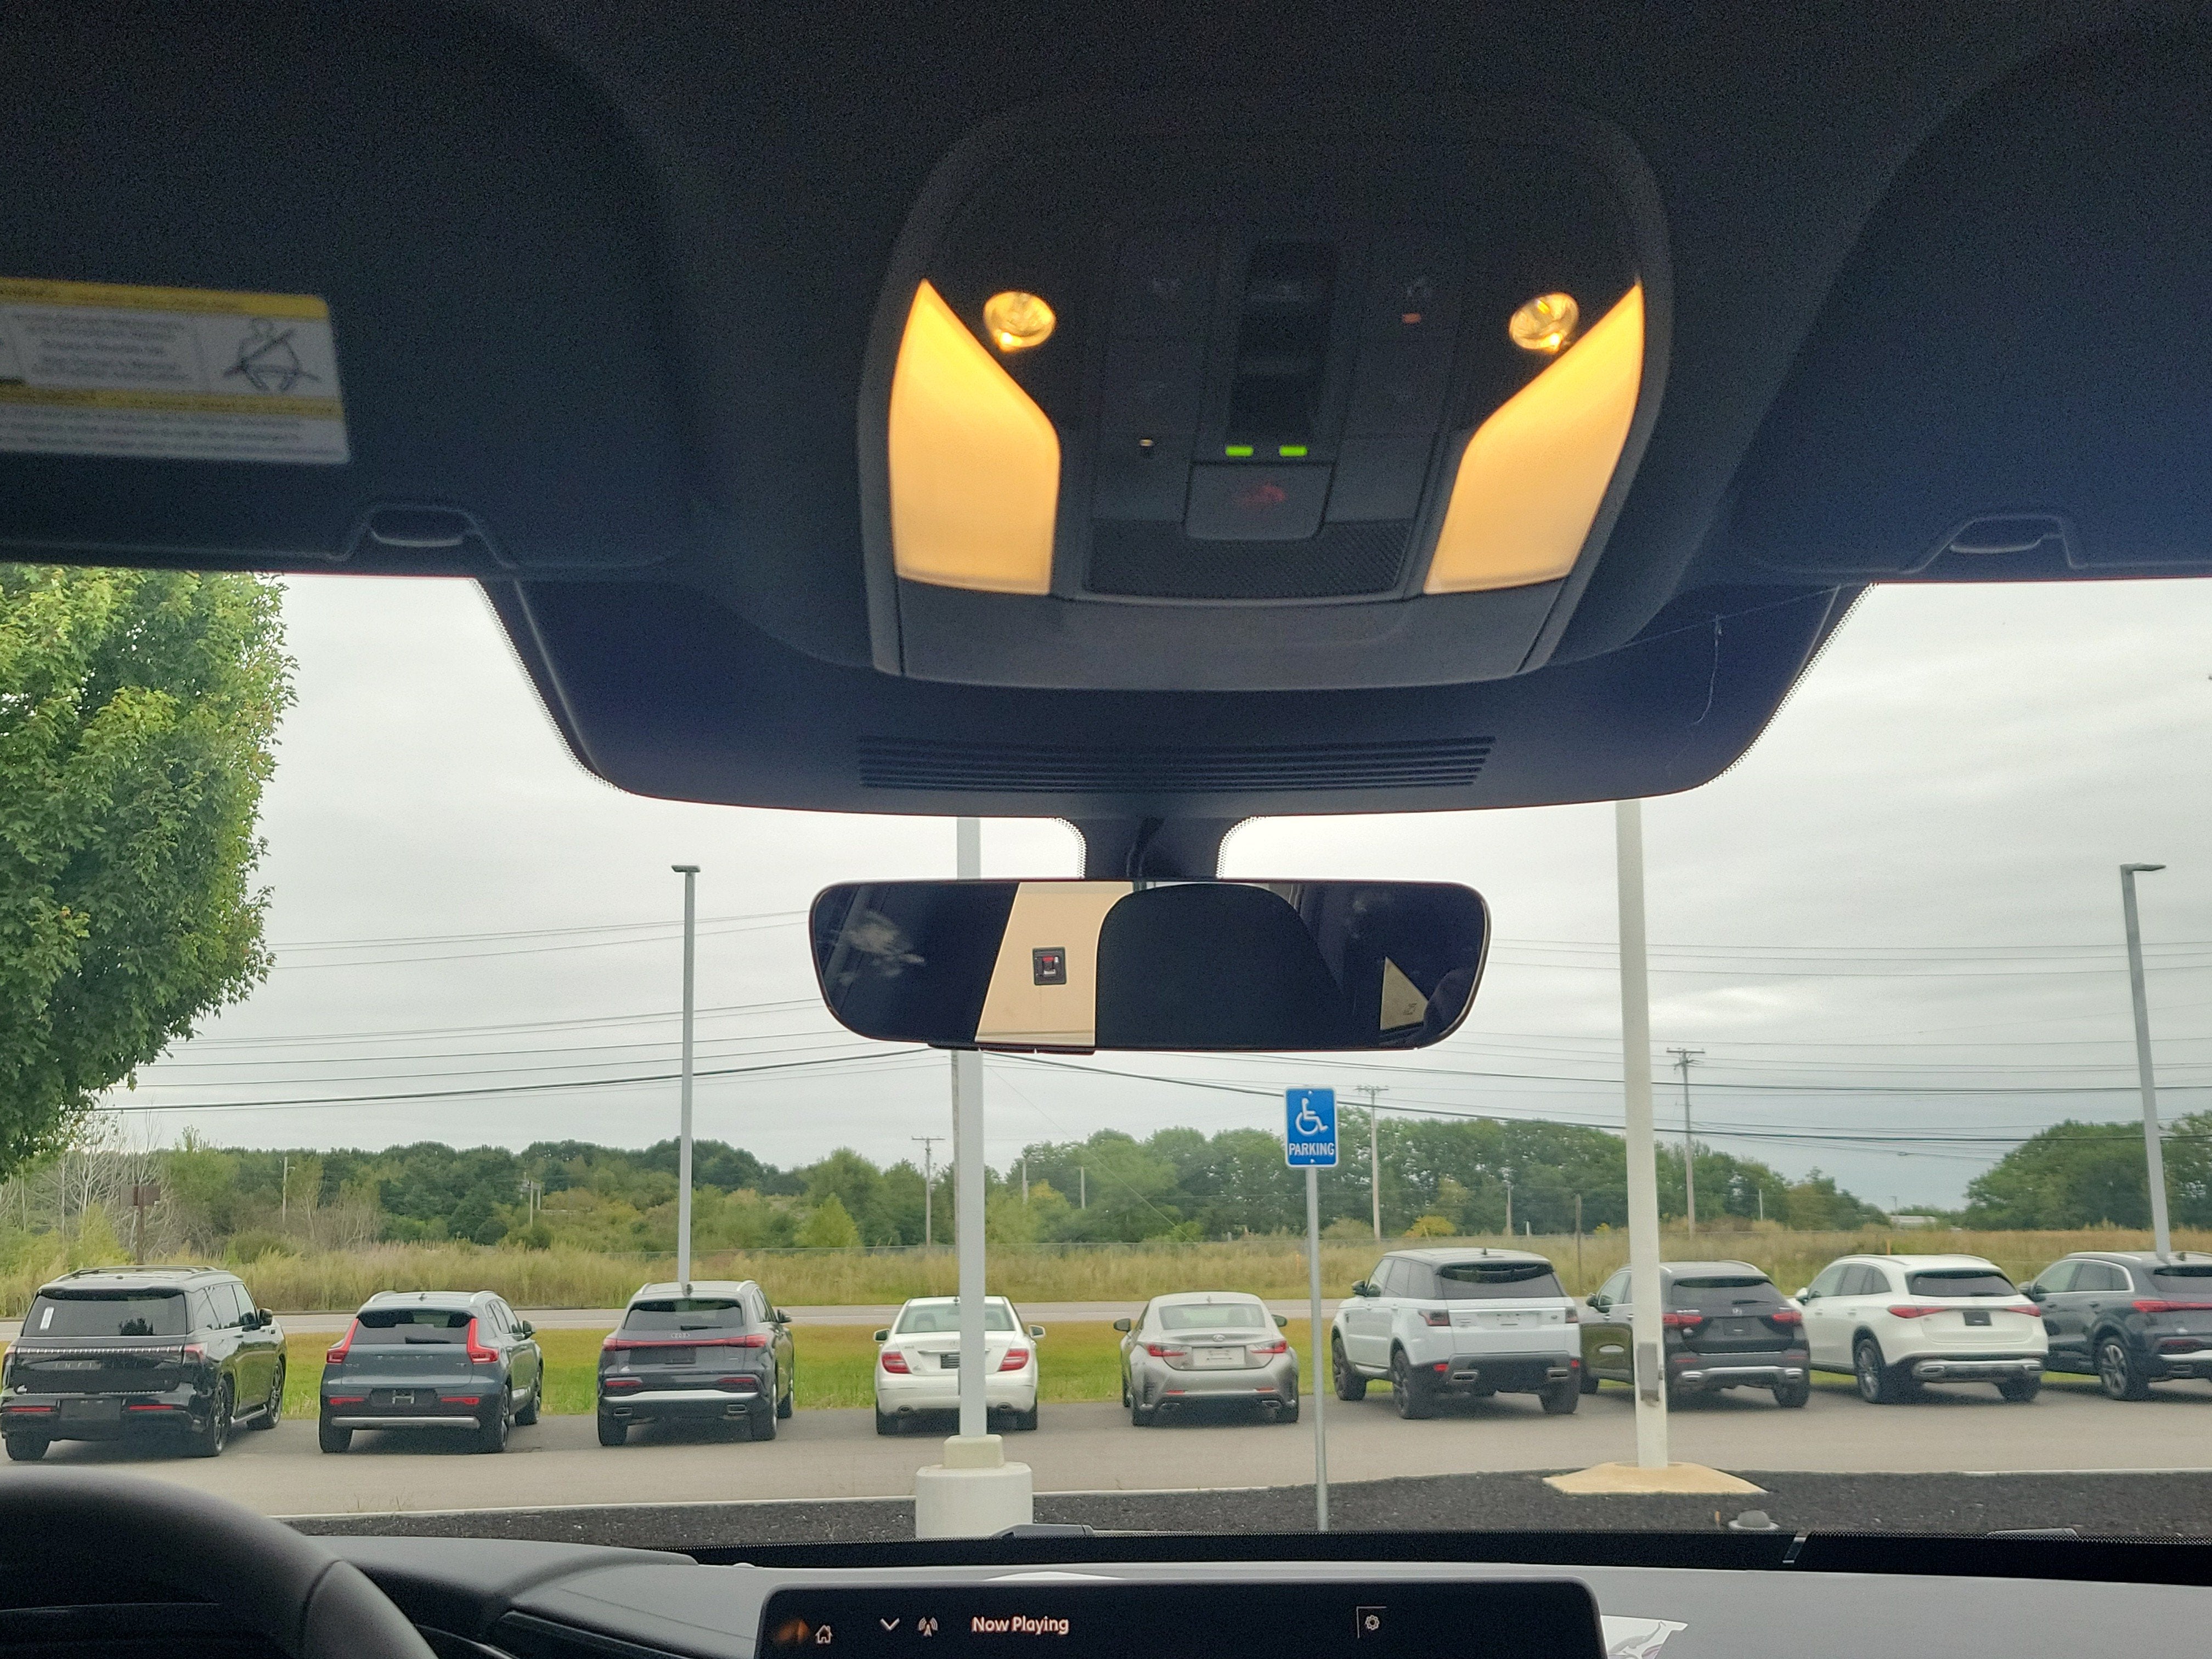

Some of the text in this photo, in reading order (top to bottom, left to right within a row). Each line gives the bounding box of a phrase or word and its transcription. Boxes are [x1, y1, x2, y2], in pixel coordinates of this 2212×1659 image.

[1289, 1142, 1335, 1156] PARKING
[972, 1615, 1069, 1635] Now Playing
